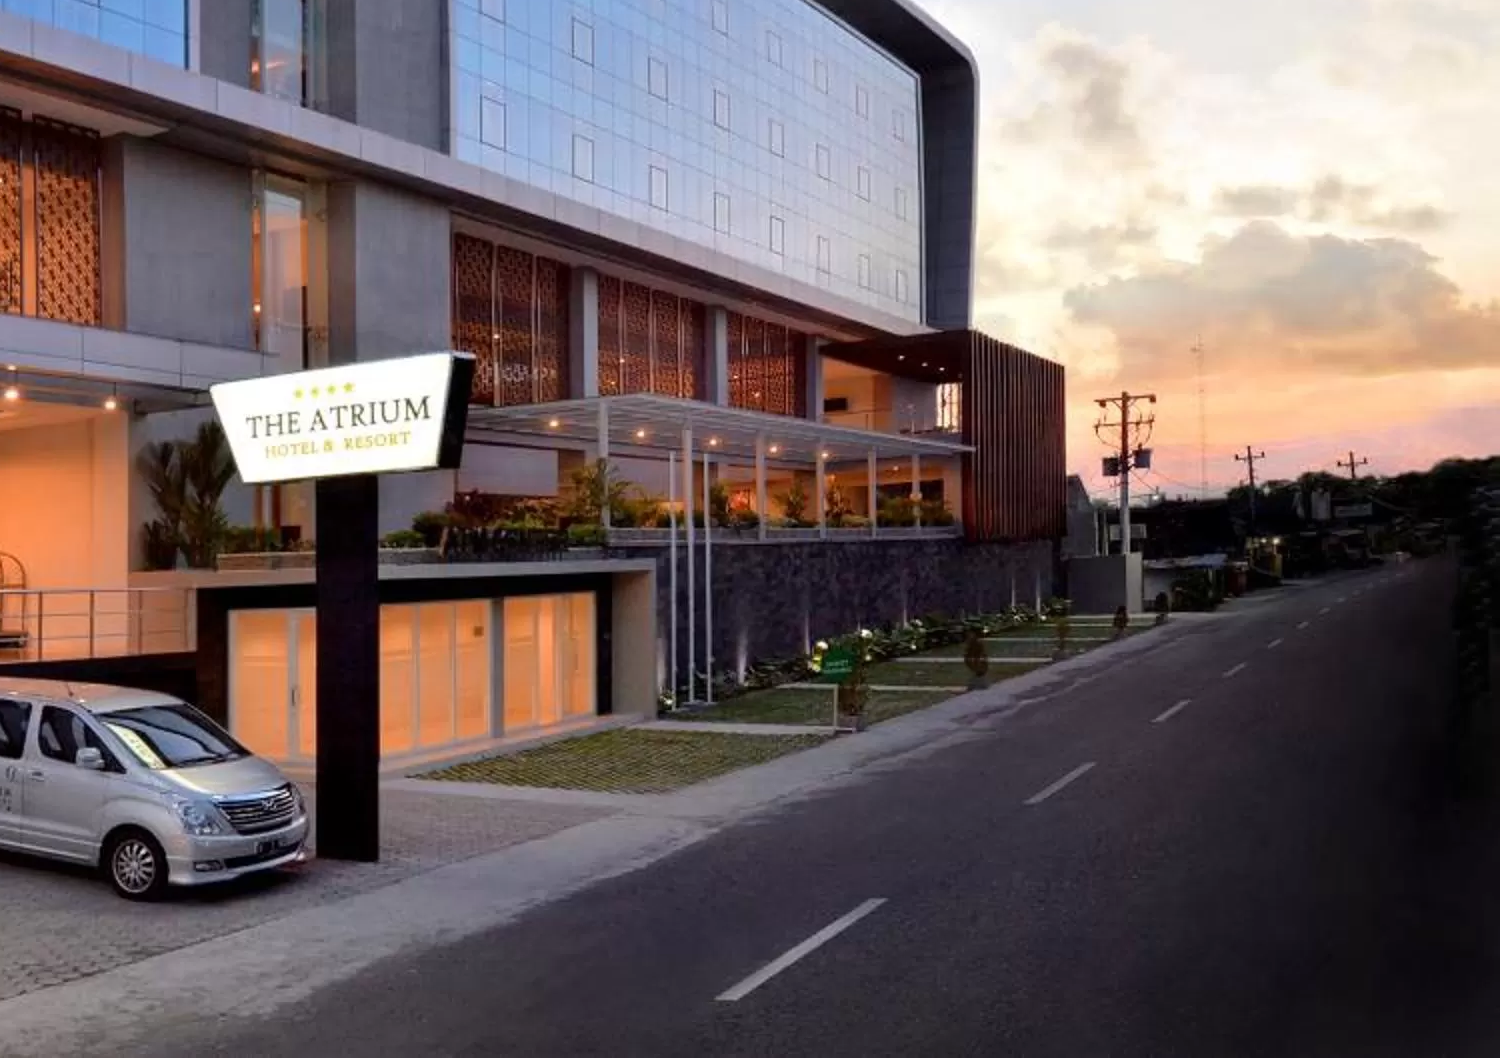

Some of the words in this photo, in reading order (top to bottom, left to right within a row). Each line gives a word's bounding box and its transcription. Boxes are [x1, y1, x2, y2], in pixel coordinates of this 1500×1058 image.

[246, 411, 301, 438] THE
[309, 396, 431, 432] ATRIUM
[265, 441, 318, 458] HOTEL
[323, 439, 334, 453] &
[344, 431, 411, 450] RESORT
